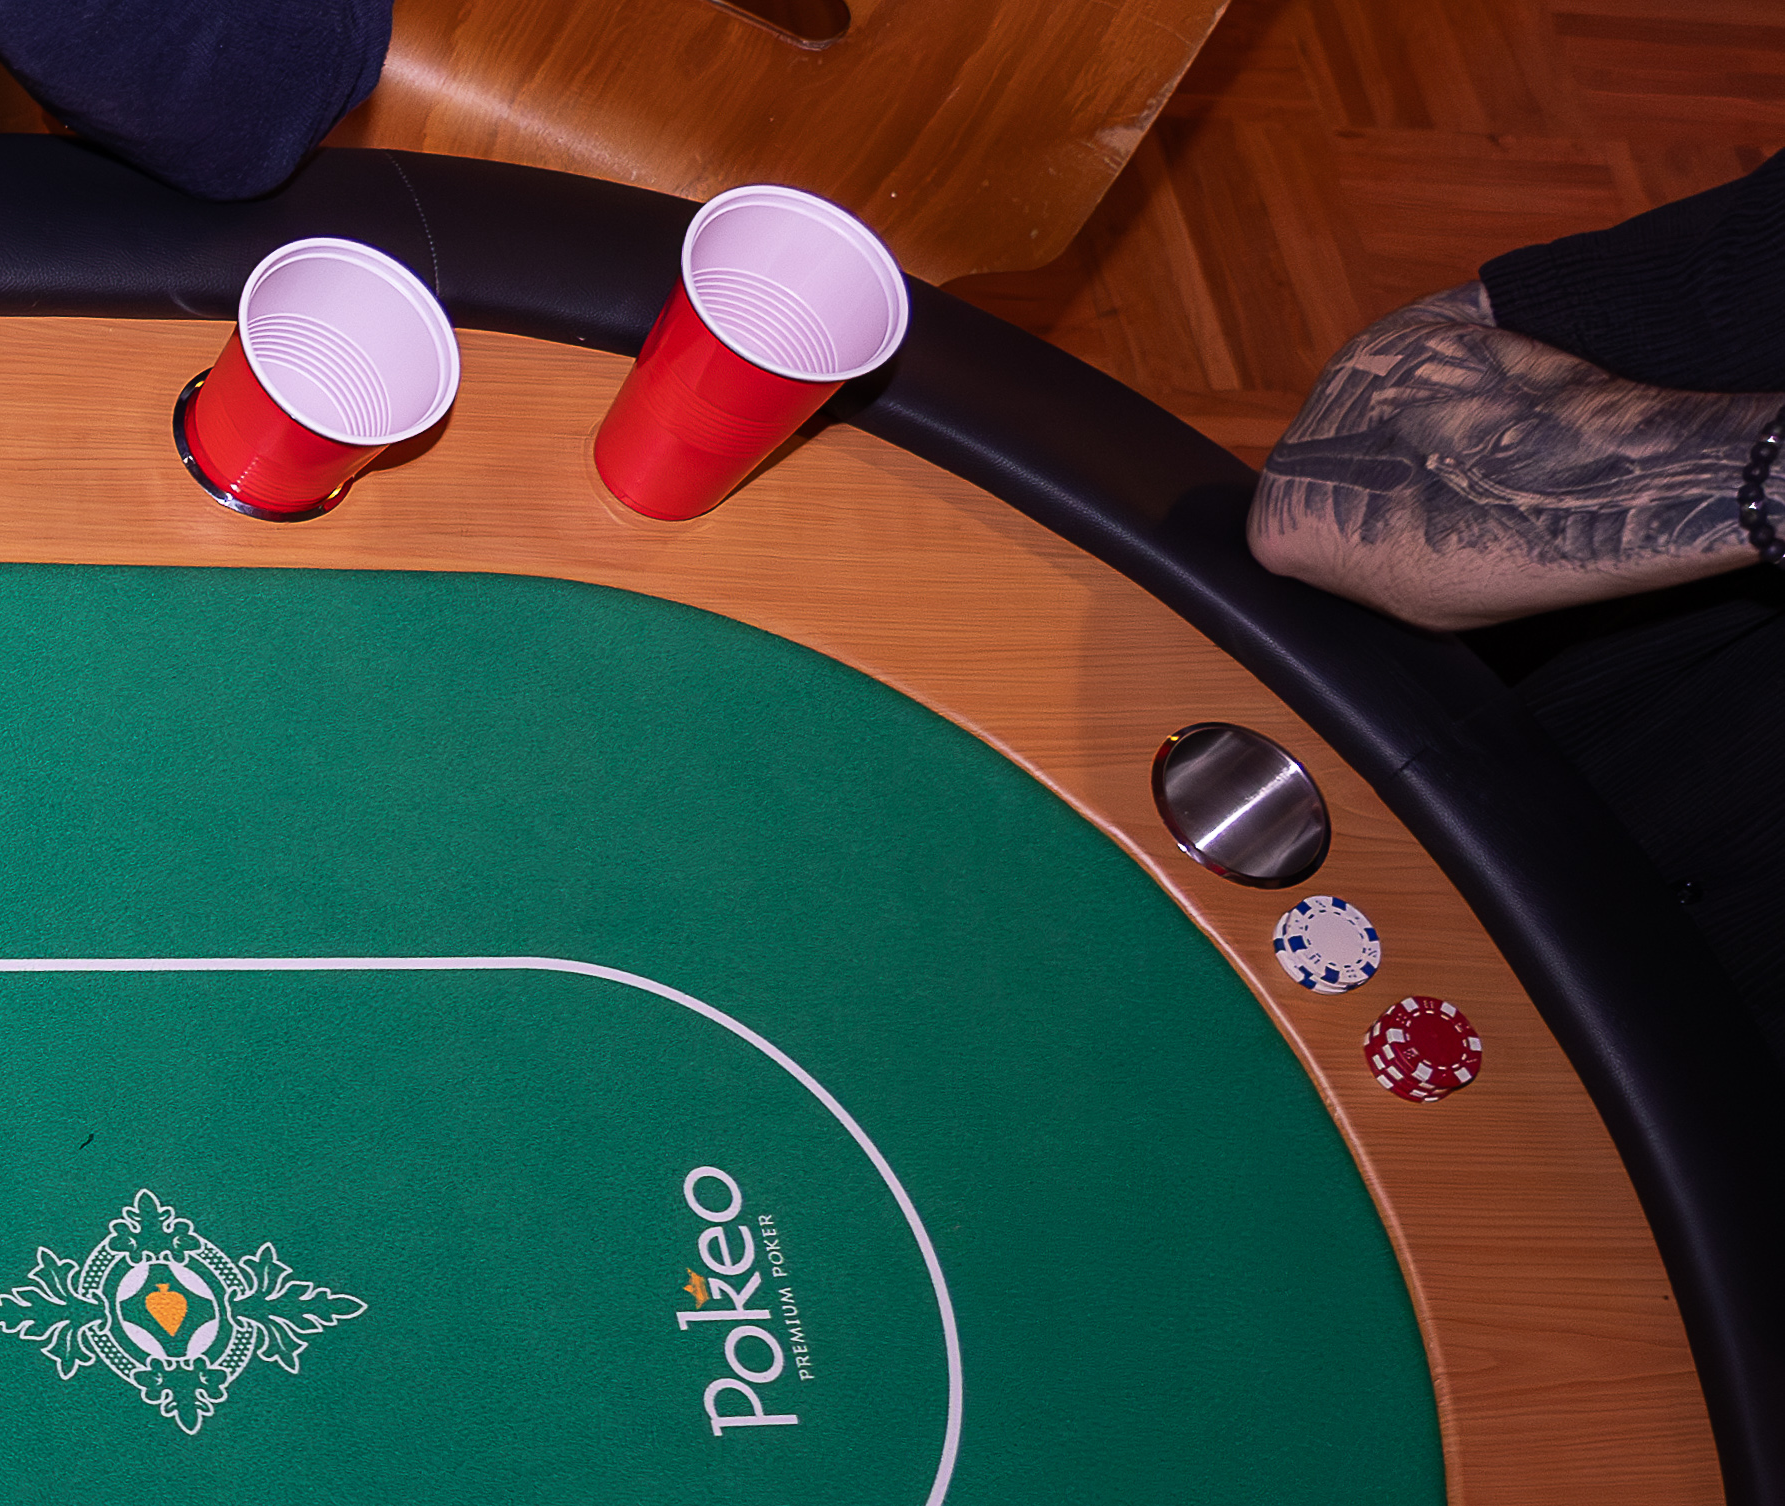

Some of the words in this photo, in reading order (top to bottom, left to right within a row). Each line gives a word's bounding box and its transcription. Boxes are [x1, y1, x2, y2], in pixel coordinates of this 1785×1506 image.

[758, 1213, 787, 1278] POKER
[676, 1166, 798, 1436] Pokeo
[778, 1287, 814, 1381] PREMIUM
